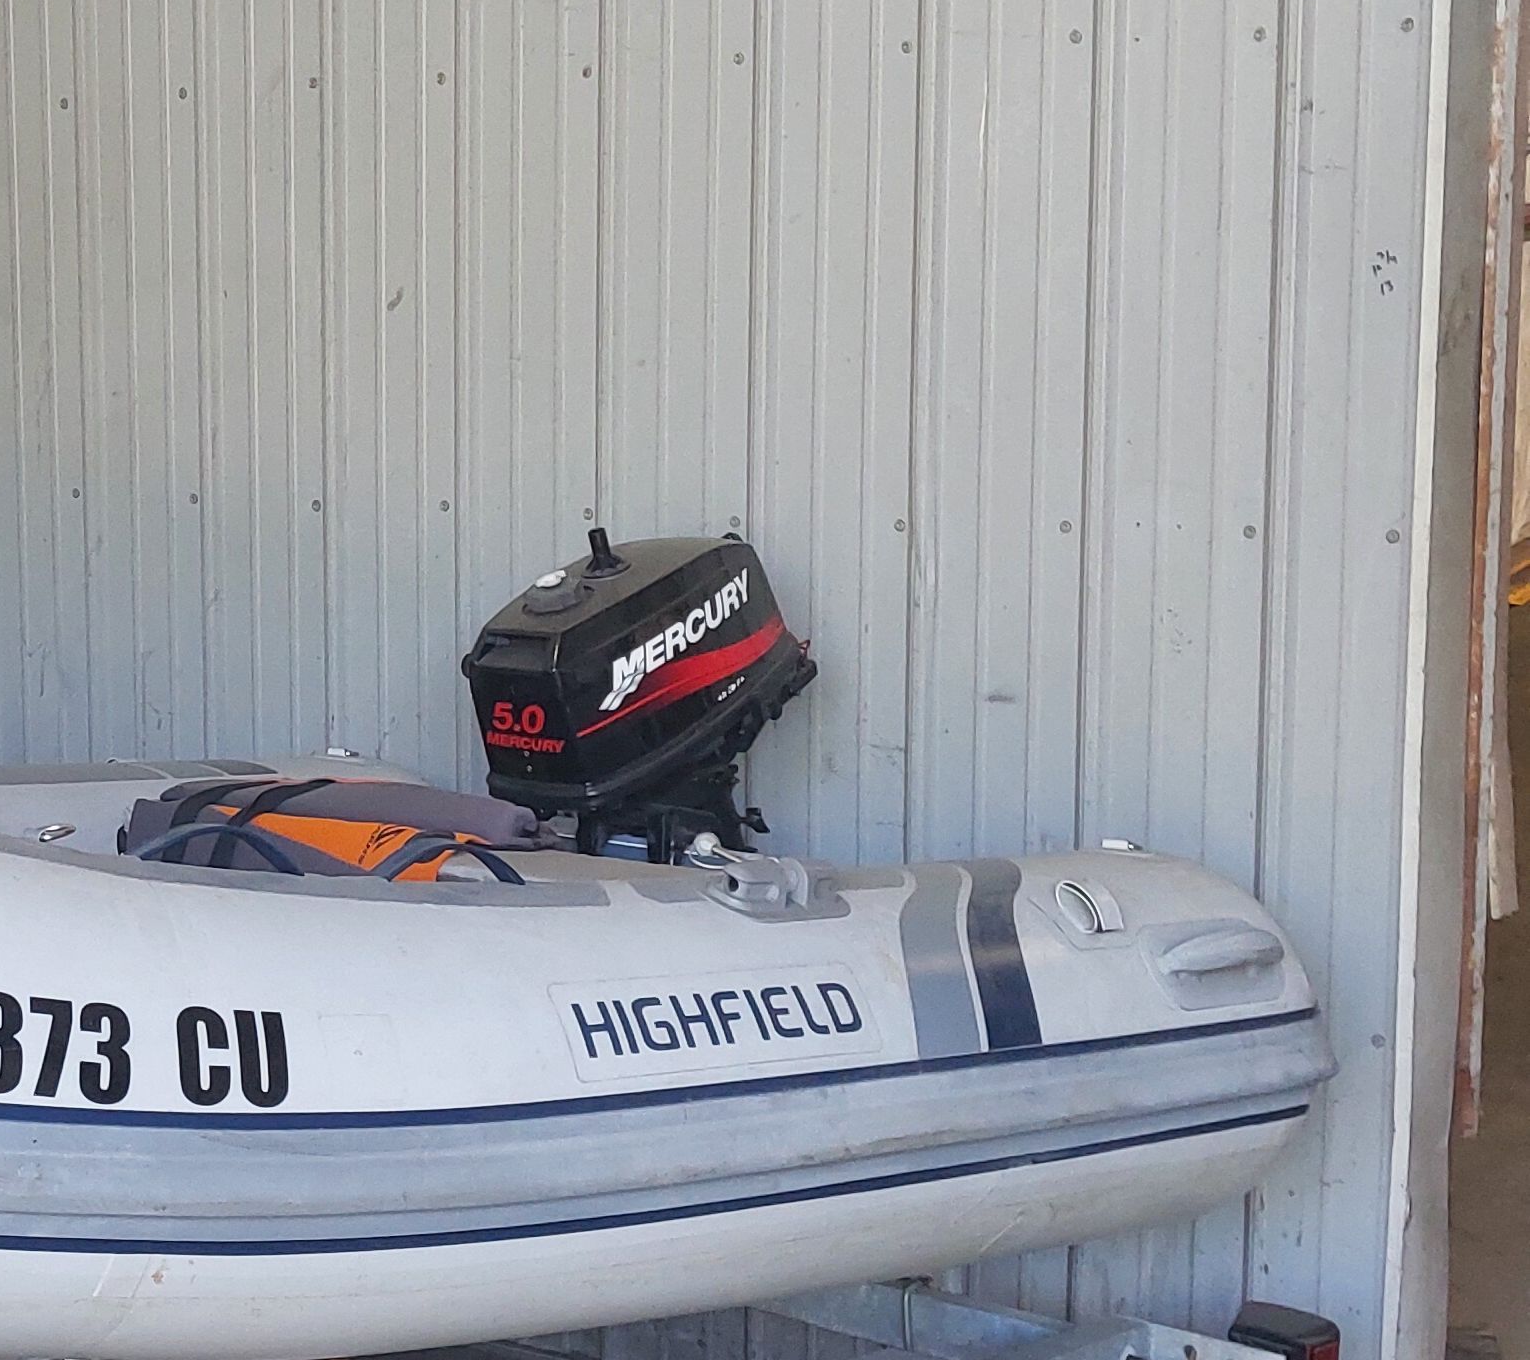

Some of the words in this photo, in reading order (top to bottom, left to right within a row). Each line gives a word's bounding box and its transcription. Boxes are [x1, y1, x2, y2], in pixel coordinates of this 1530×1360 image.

[599, 568, 749, 711] MERCURY
[485, 731, 566, 753] MERCURY
[492, 701, 546, 735] 5.0
[176, 1005, 289, 1108] CU
[571, 982, 863, 1059] HIGHFIELD
